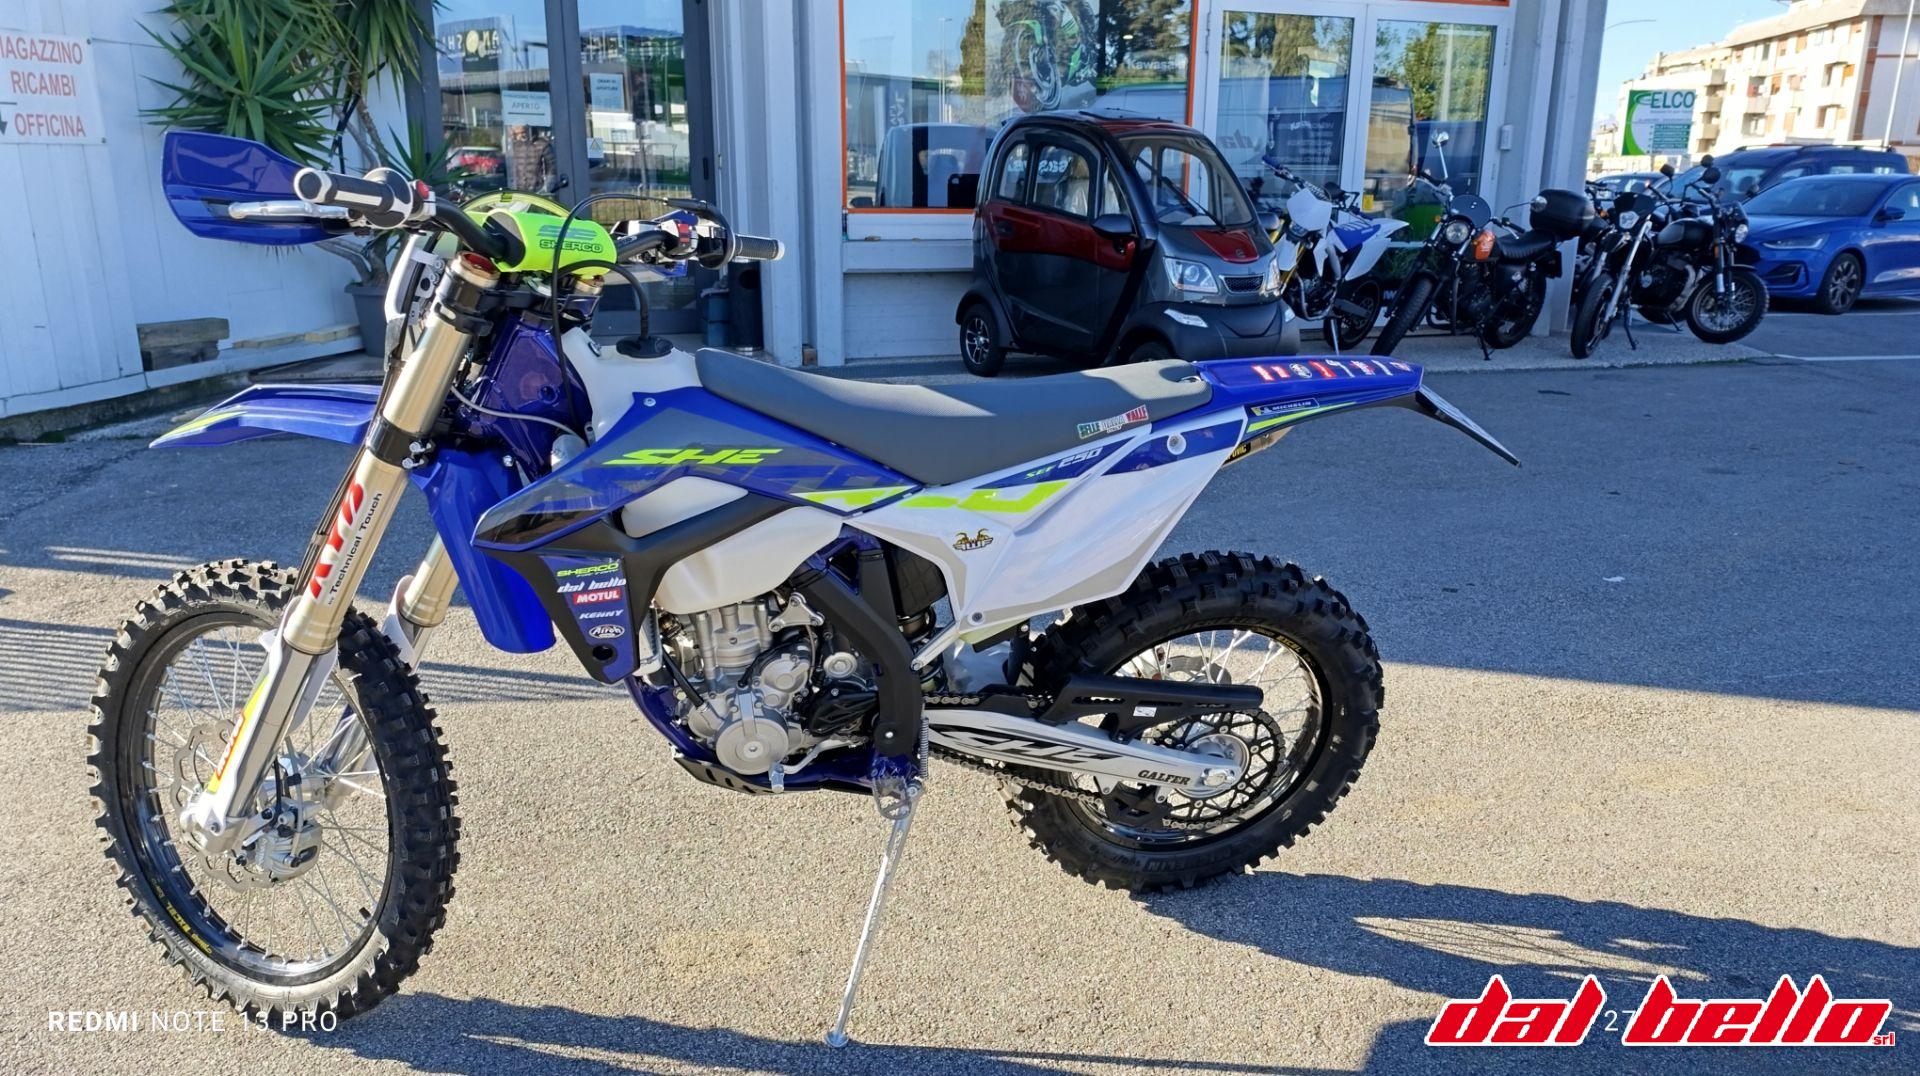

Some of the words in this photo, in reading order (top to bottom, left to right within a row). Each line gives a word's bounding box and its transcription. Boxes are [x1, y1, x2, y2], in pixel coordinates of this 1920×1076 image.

[10, 70, 76, 97] RICAMBI
[511, 102, 540, 110] APERTO
[15, 113, 87, 137] OFFICINA
[1058, 447, 1104, 469] 250
[329, 536, 362, 595] Technical
[360, 493, 383, 531] Touch
[557, 562, 619, 577] SHERCO
[576, 590, 619, 603] MOTUL
[579, 609, 624, 620] KENNY
[1138, 769, 1190, 786] GALFER
